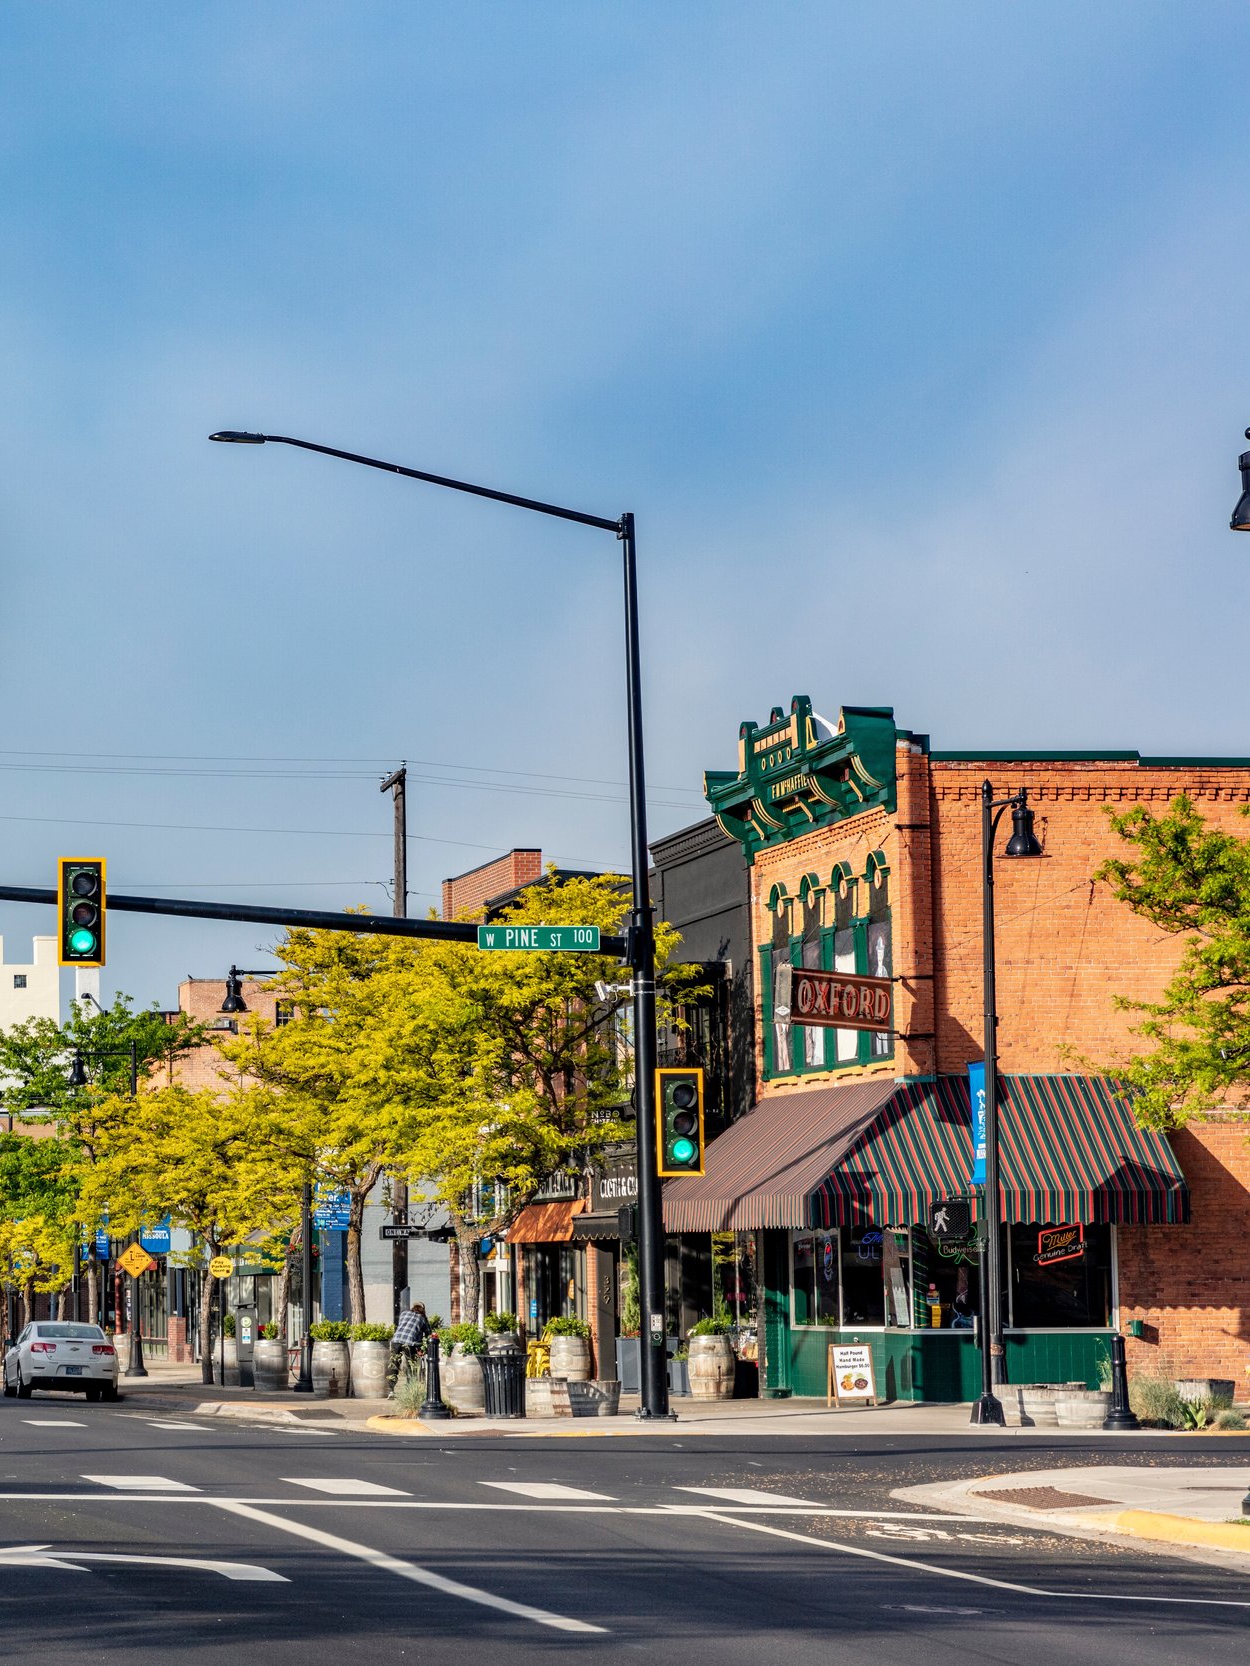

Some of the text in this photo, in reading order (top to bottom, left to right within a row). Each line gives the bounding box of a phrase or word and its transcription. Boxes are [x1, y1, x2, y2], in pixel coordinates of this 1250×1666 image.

[486, 929, 593, 947] W PINE ST 100
[797, 979, 890, 1020] OXFORD
[1042, 1231, 1077, 1248] Miller
[1032, 1241, 1088, 1262] Genuine Draft
